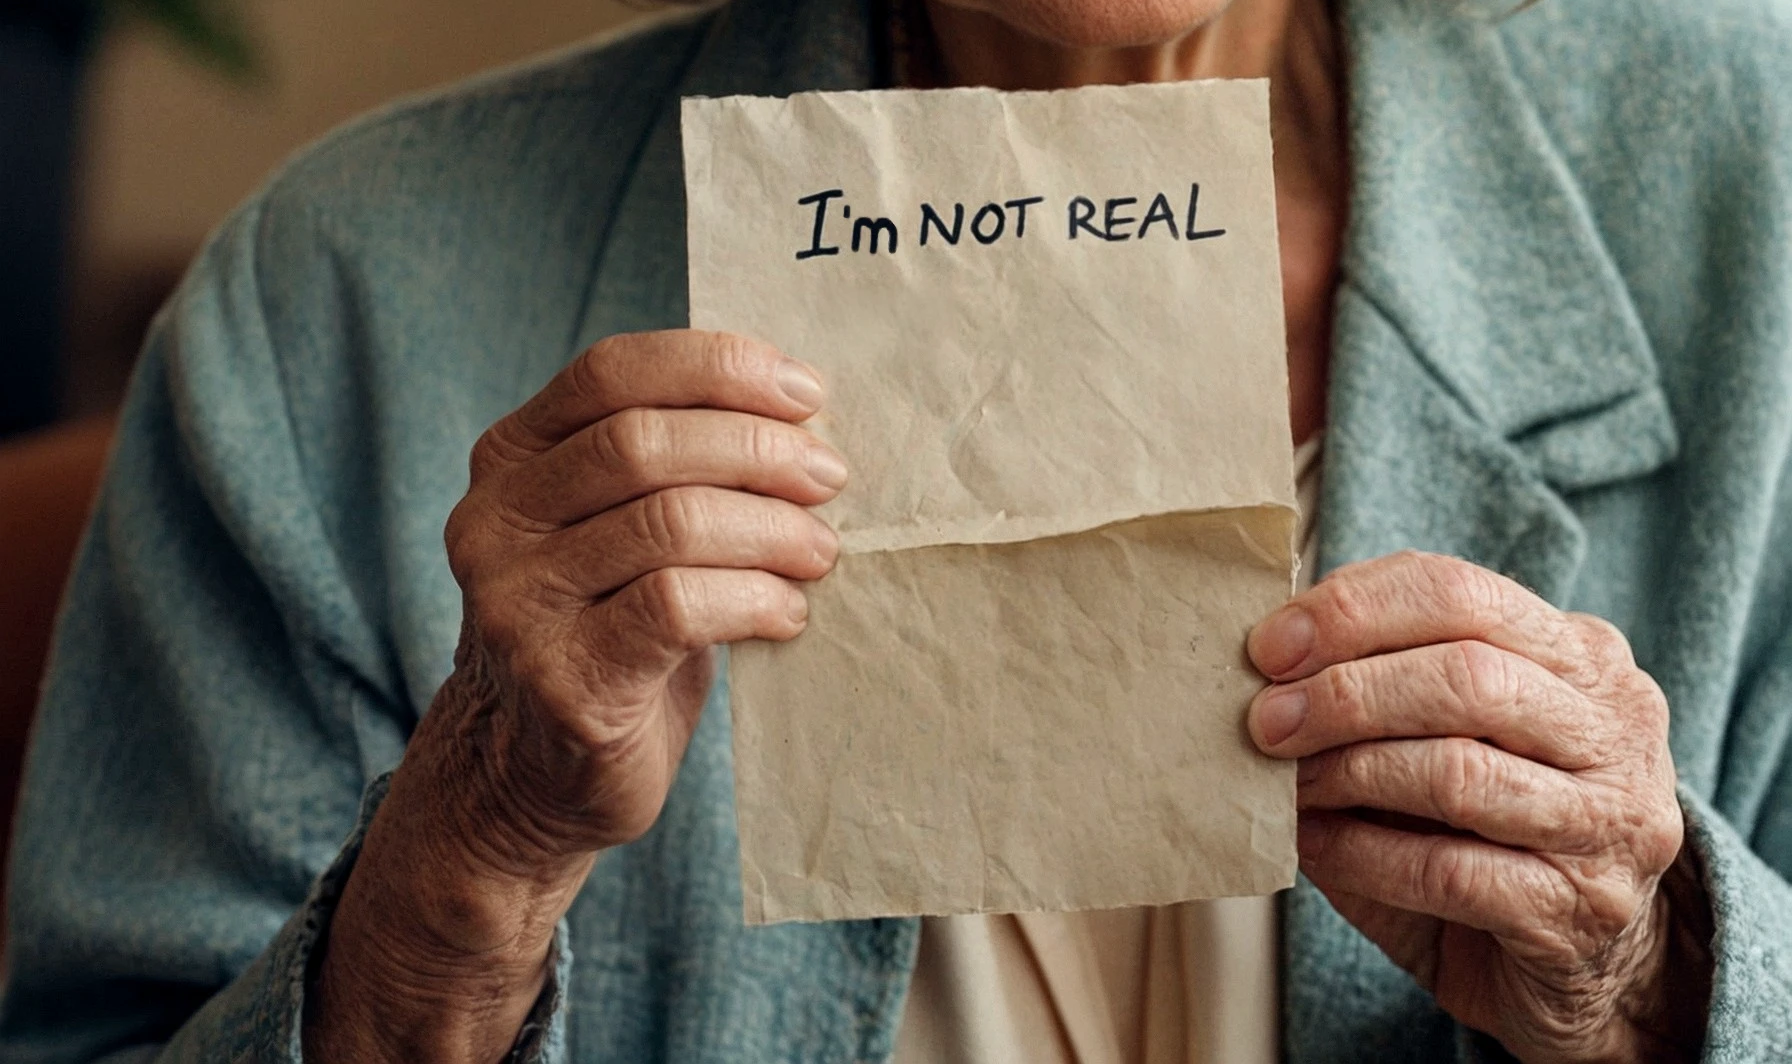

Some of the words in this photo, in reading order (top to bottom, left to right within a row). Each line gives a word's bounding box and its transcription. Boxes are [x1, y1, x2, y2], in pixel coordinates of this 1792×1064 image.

[795, 189, 898, 260] I'm
[919, 196, 1044, 246] NOT
[1068, 182, 1226, 242] REAL
